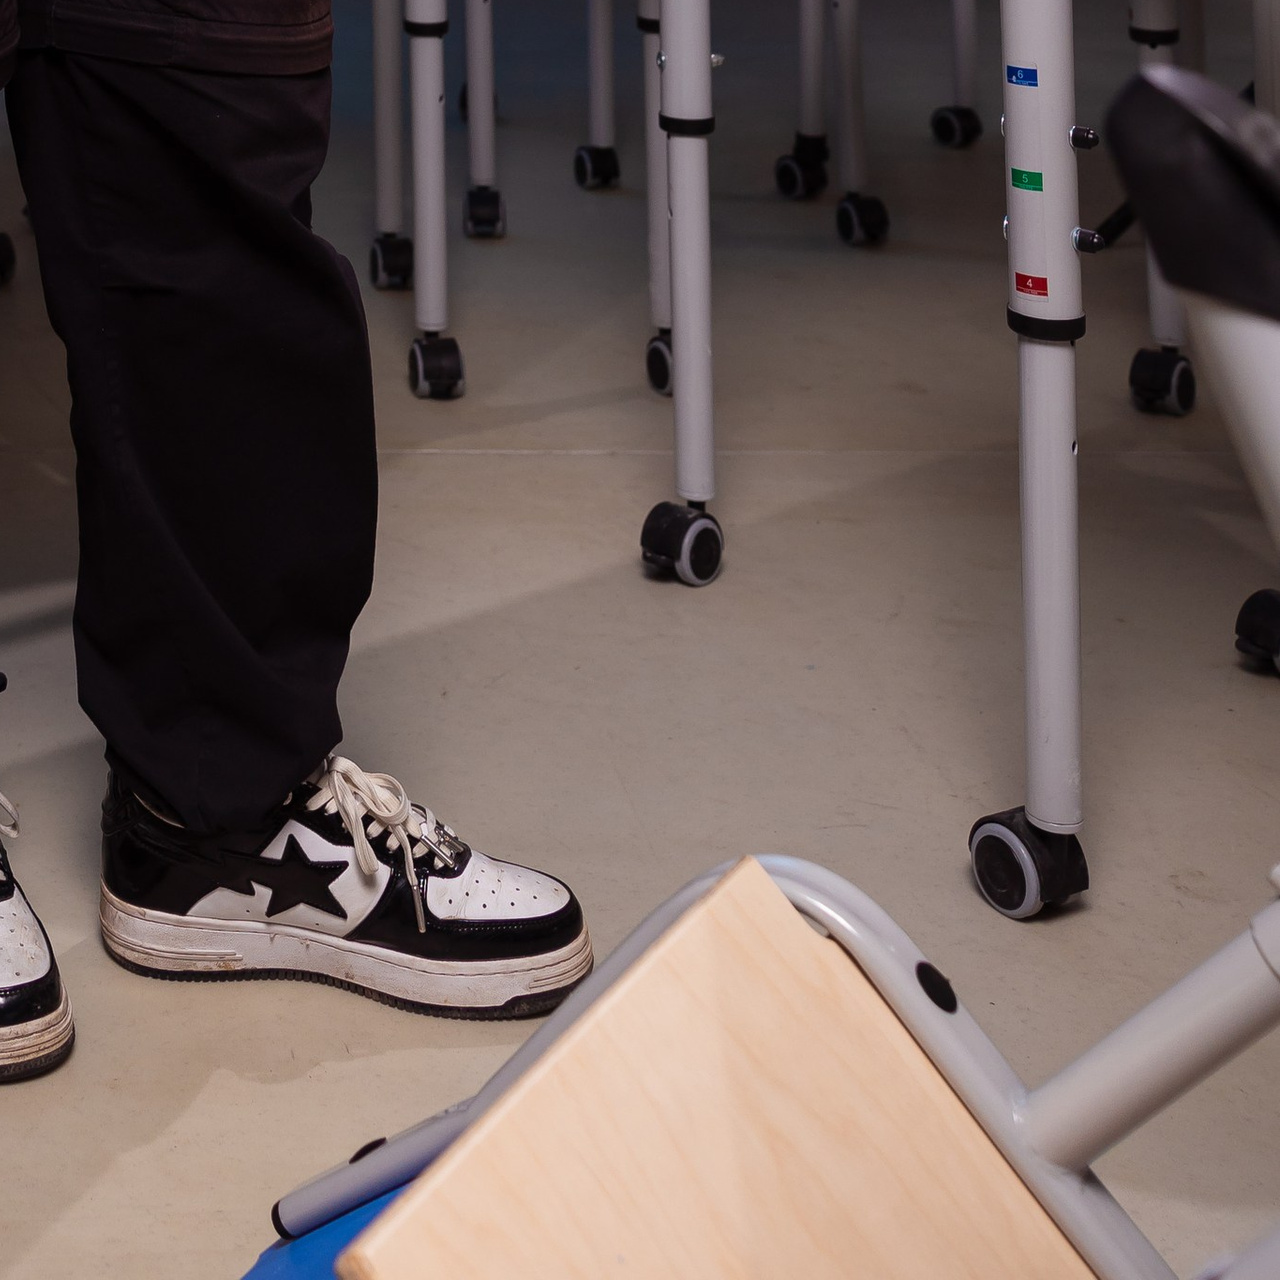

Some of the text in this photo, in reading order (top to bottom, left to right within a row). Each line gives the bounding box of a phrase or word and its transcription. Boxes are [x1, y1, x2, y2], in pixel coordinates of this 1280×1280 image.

[1017, 69, 1024, 79] 6
[1022, 173, 1028, 183] 5
[1026, 278, 1033, 288] 4
